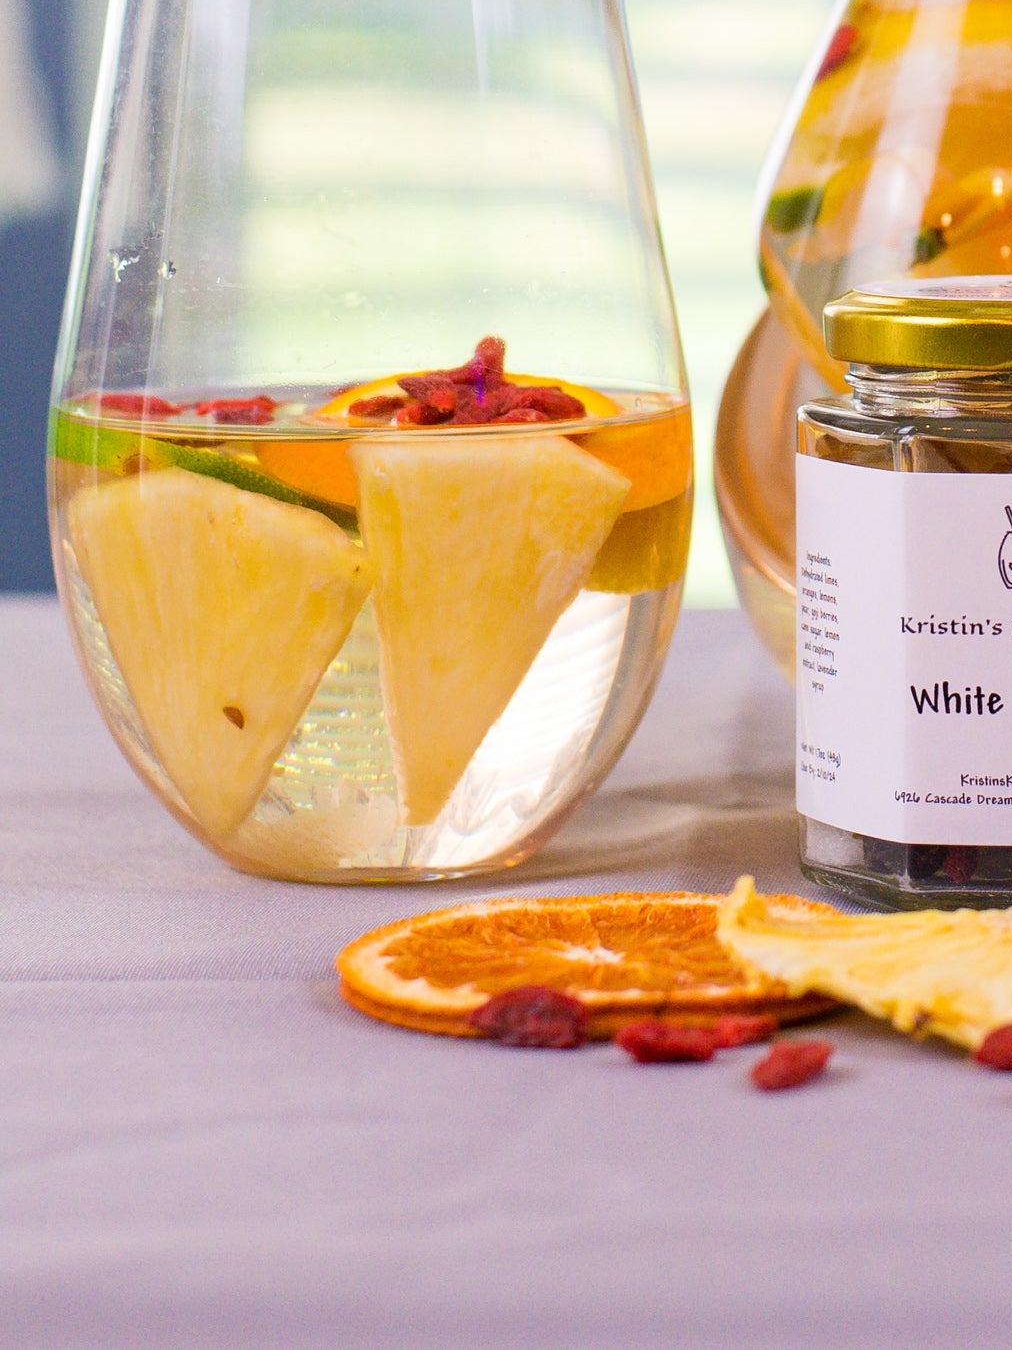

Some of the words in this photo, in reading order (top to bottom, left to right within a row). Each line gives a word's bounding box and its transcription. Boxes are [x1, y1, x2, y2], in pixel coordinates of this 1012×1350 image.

[899, 614, 1003, 636] Kristin's
[910, 680, 1004, 715] White
[894, 791, 921, 804] 6926
[925, 793, 972, 805] Cascade
